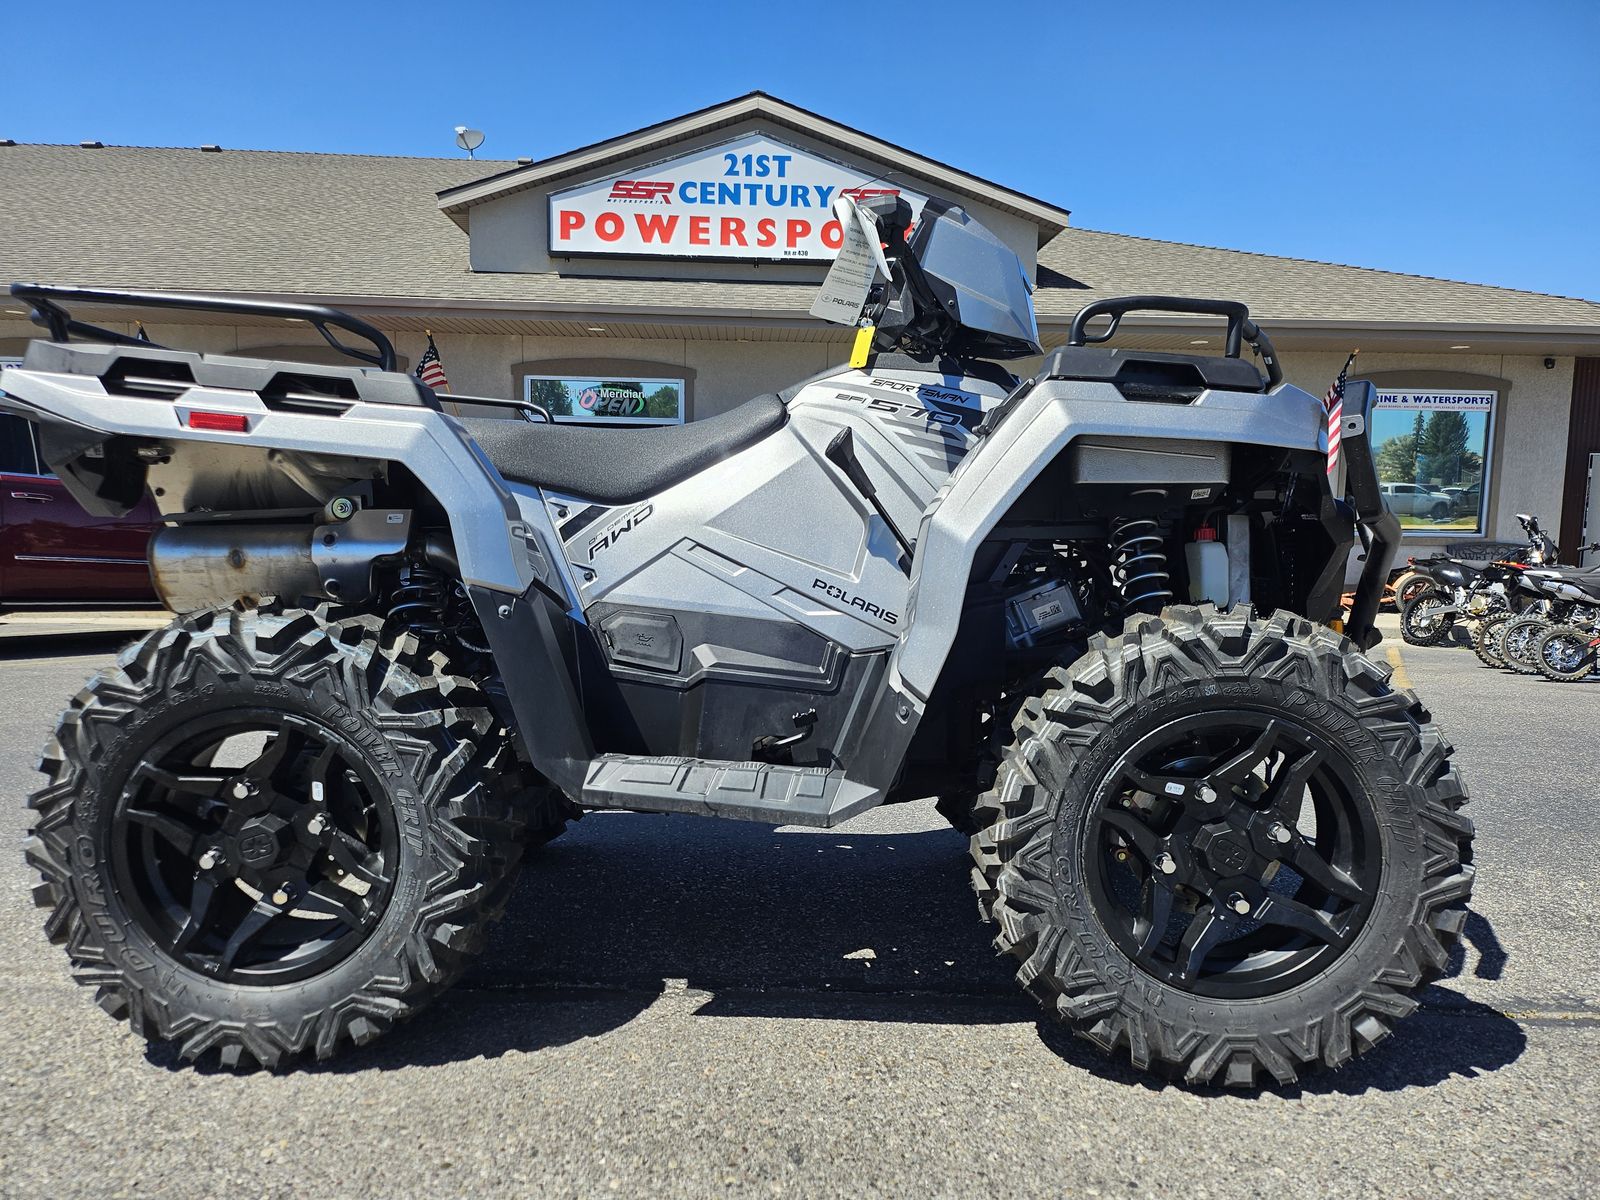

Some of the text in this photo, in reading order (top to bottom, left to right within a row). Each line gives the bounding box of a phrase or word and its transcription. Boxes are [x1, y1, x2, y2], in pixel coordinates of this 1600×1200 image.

[724, 153, 792, 178] 21ST
[609, 180, 675, 204] SSR
[679, 181, 835, 208] CENTURY
[560, 210, 915, 250] POWERSPO
[832, 297, 860, 309] POLARIS
[579, 391, 637, 416] OPEN
[601, 388, 645, 399] Meridian
[870, 378, 970, 404] SPORTSMAN
[1401, 395, 1409, 403] &
[1413, 395, 1491, 405] WATERSPORTS
[835, 393, 961, 426] EFI 570
[588, 504, 654, 561] AWD
[812, 578, 899, 625] POLARIS
[321, 703, 403, 779] POWER
[396, 788, 424, 857] GRIP
[1280, 691, 1417, 853] POWER GRIP
[77, 833, 157, 973] DURO
[1056, 856, 1135, 986] DURO
